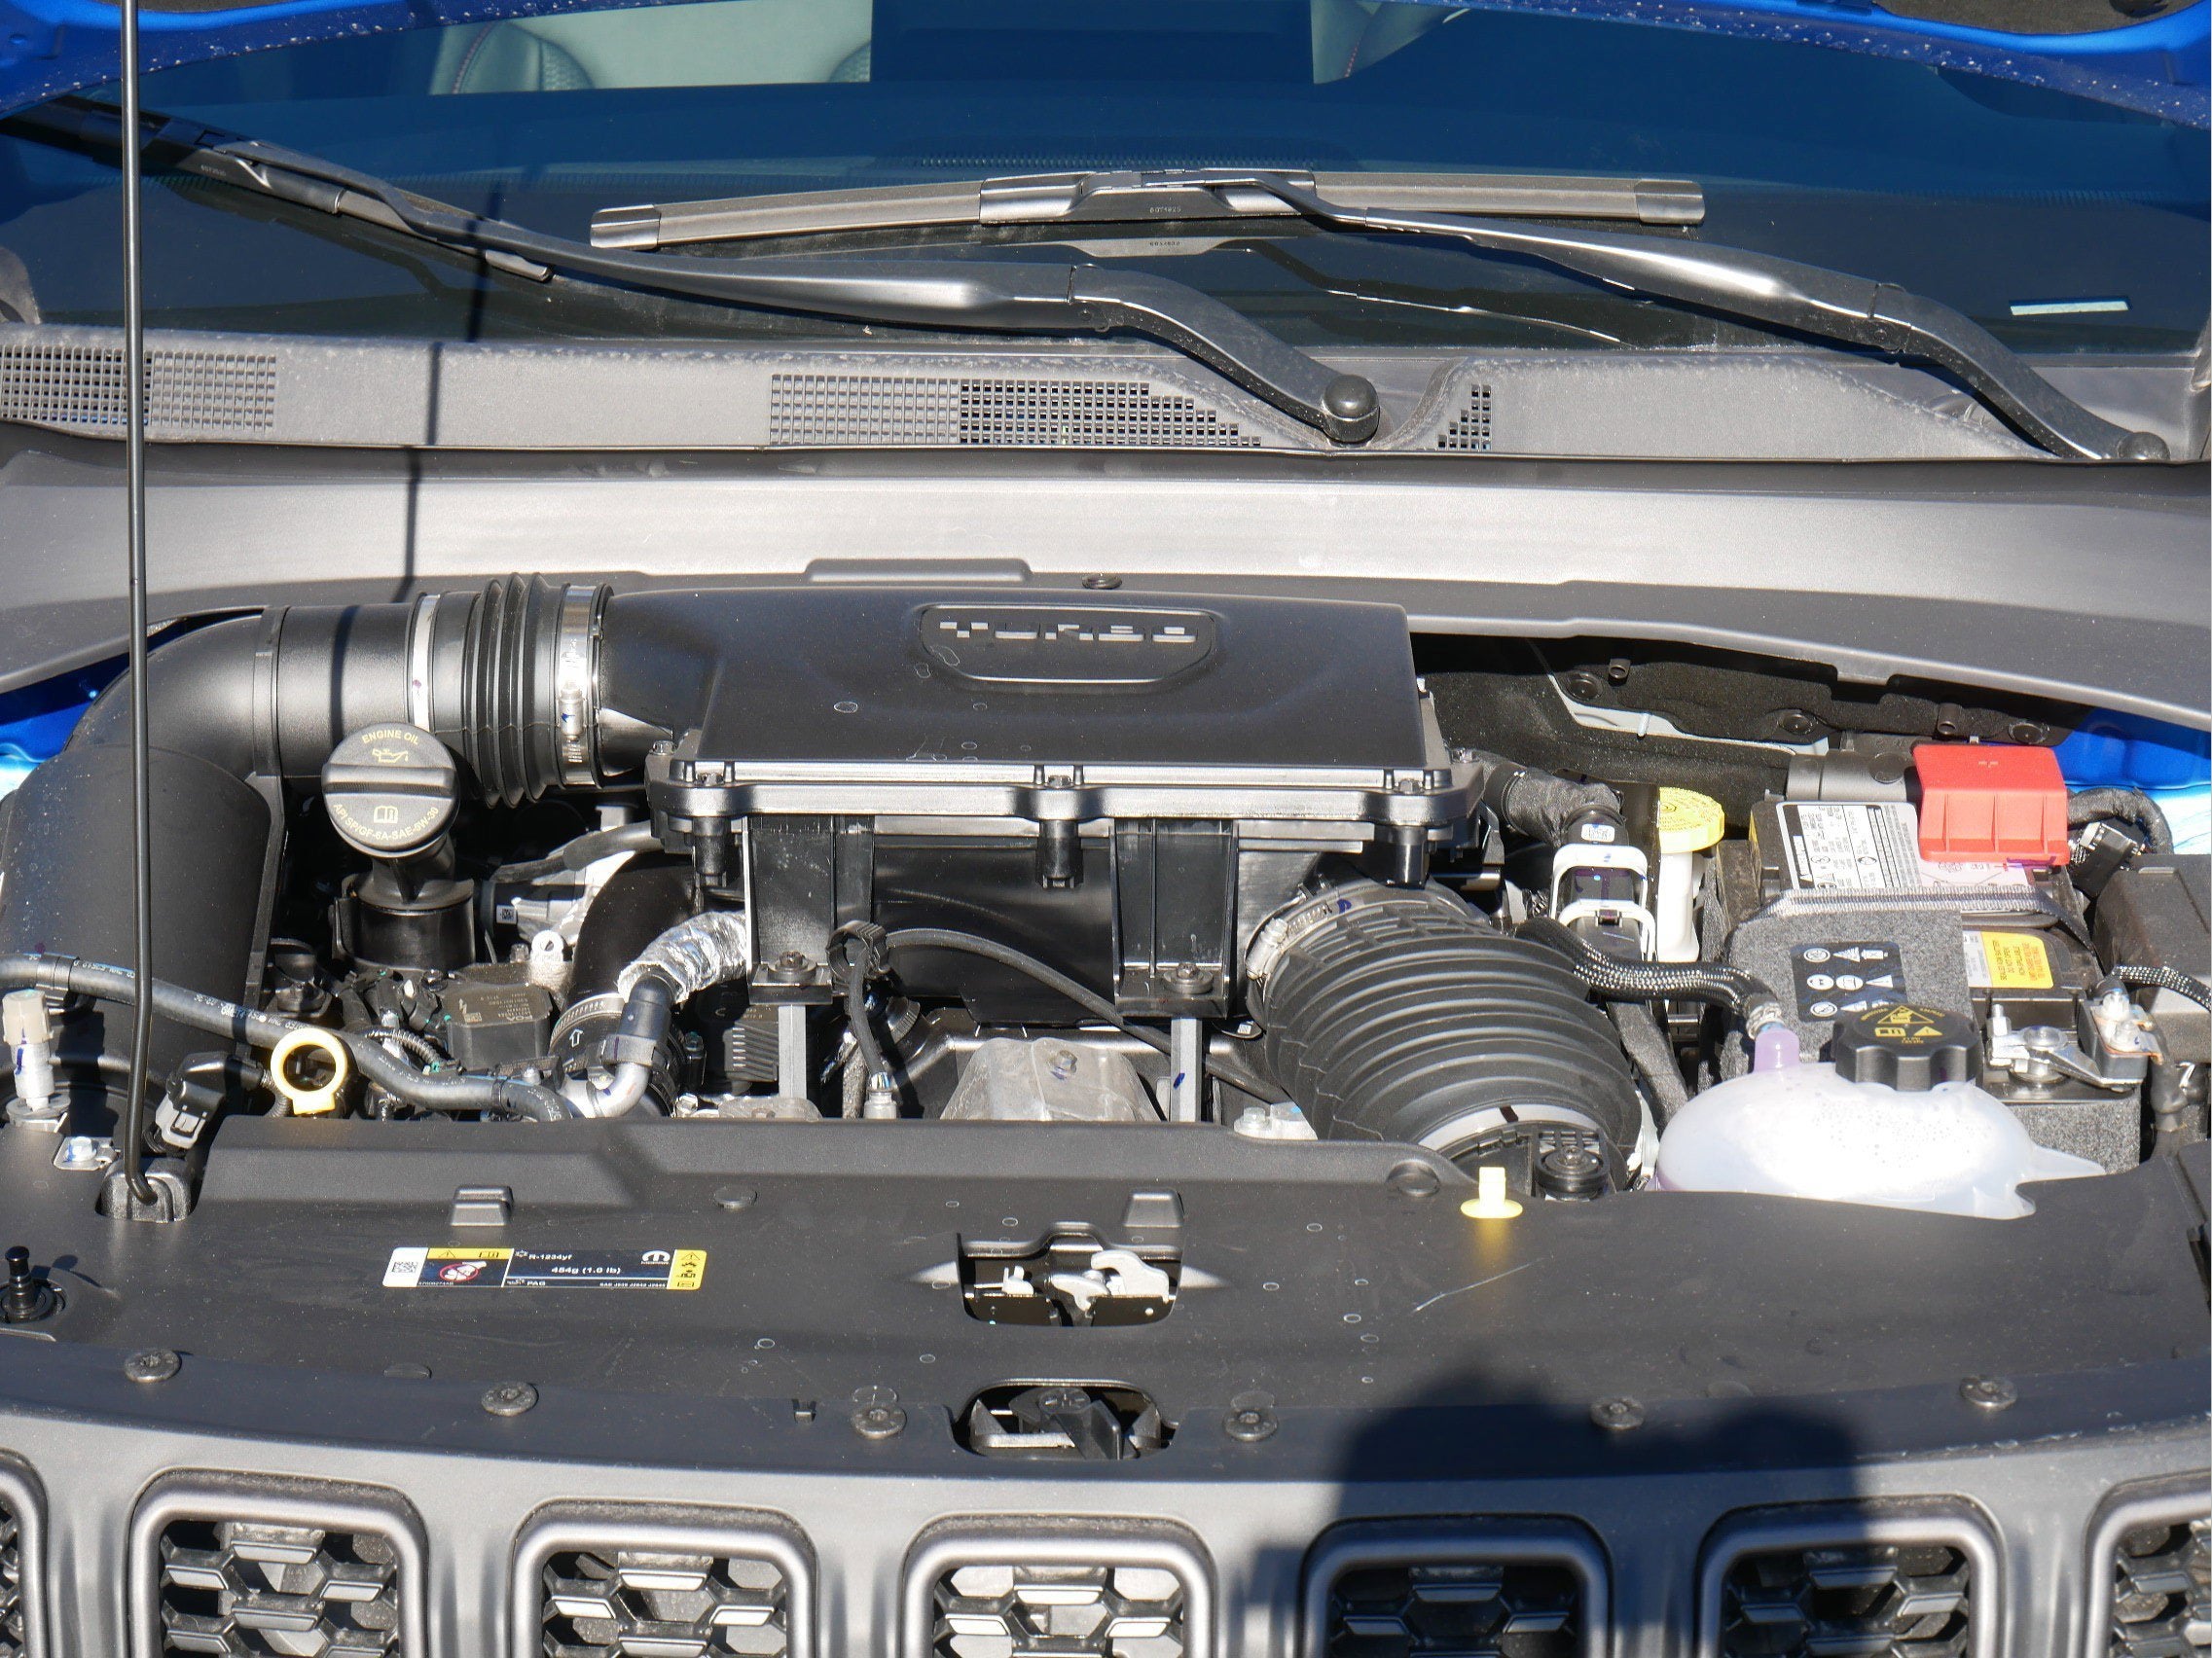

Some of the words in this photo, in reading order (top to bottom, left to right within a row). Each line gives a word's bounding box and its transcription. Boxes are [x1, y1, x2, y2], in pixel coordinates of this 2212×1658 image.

[361, 729, 402, 744] ENGINE
[403, 730, 419, 746] OIL
[333, 803, 347, 821] API
[605, 1267, 621, 1276] lb)
